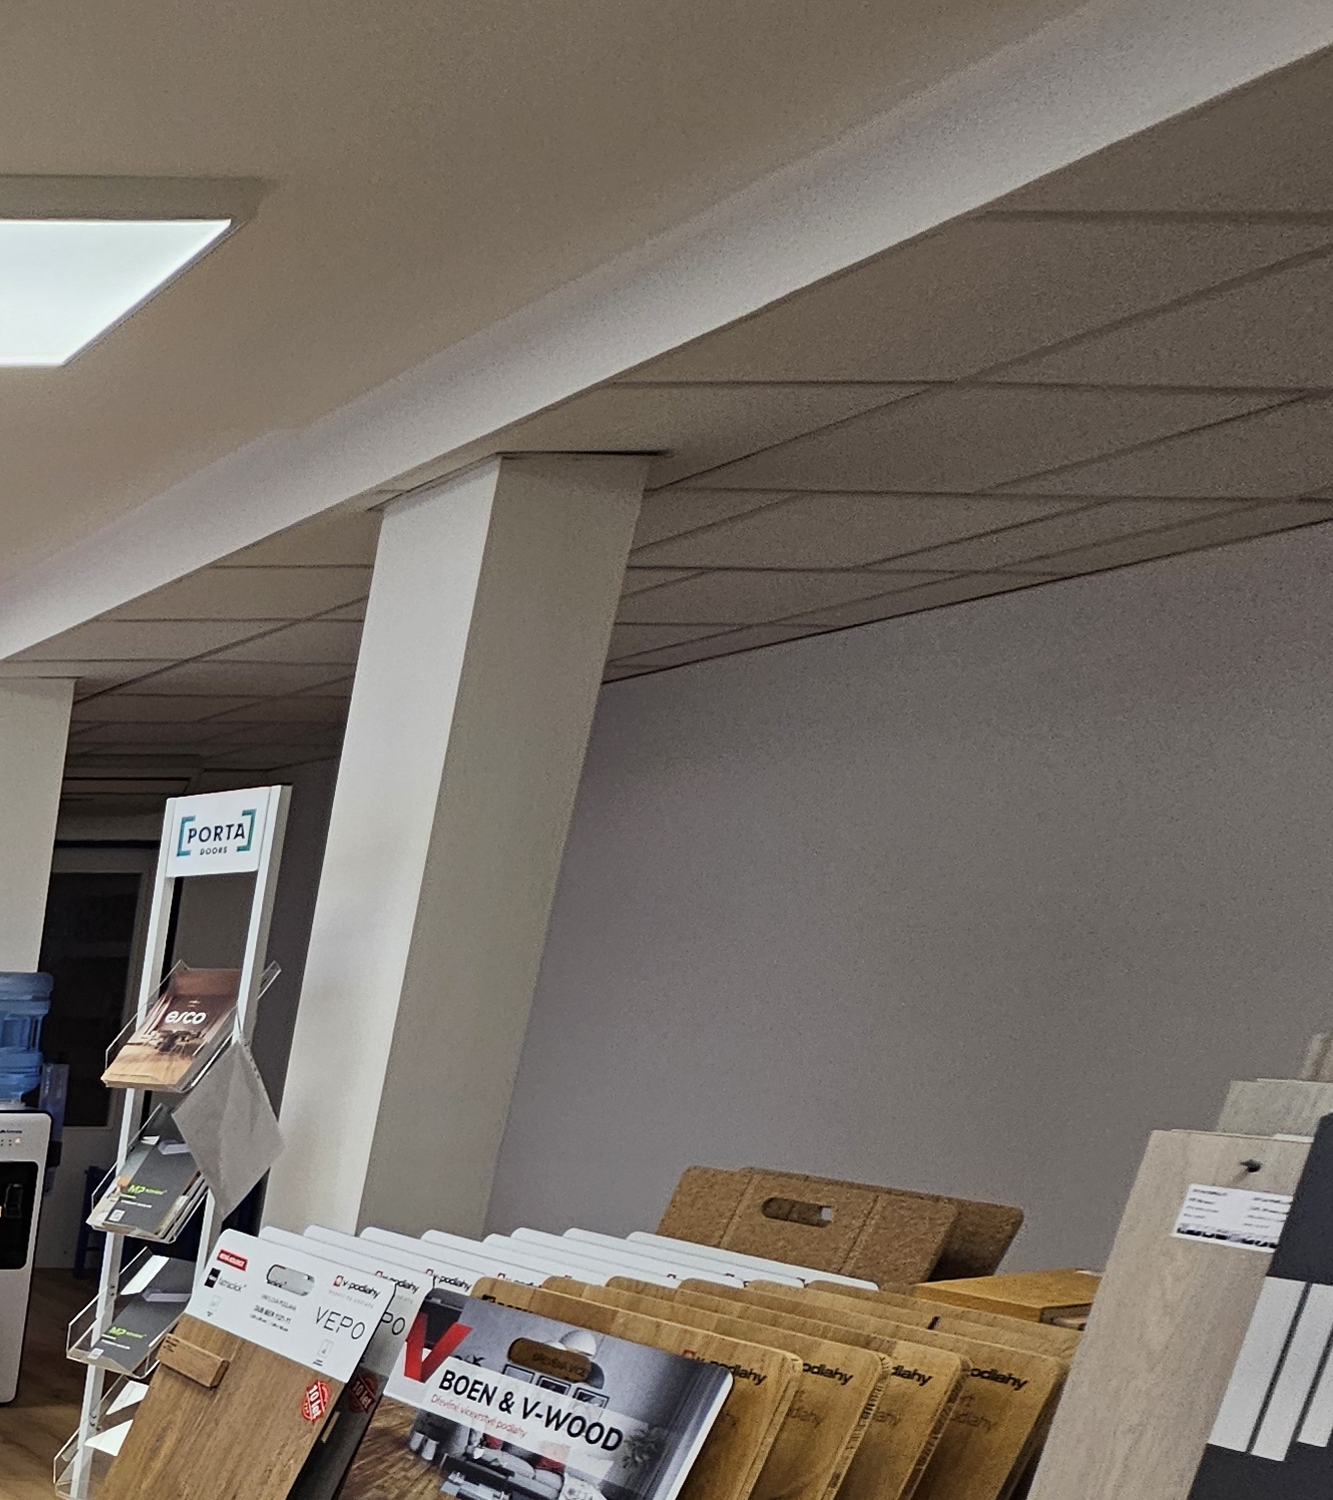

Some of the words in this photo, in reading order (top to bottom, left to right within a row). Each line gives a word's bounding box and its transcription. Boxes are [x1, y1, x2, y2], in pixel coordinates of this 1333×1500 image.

[187, 823, 245, 844] PORTA
[199, 846, 228, 855] DOORS
[315, 1306, 366, 1340] VEPO
[381, 1311, 406, 1335] PO
[438, 1369, 498, 1407] BOEN
[498, 1391, 515, 1415] &
[522, 1397, 624, 1452] V-WOOD
